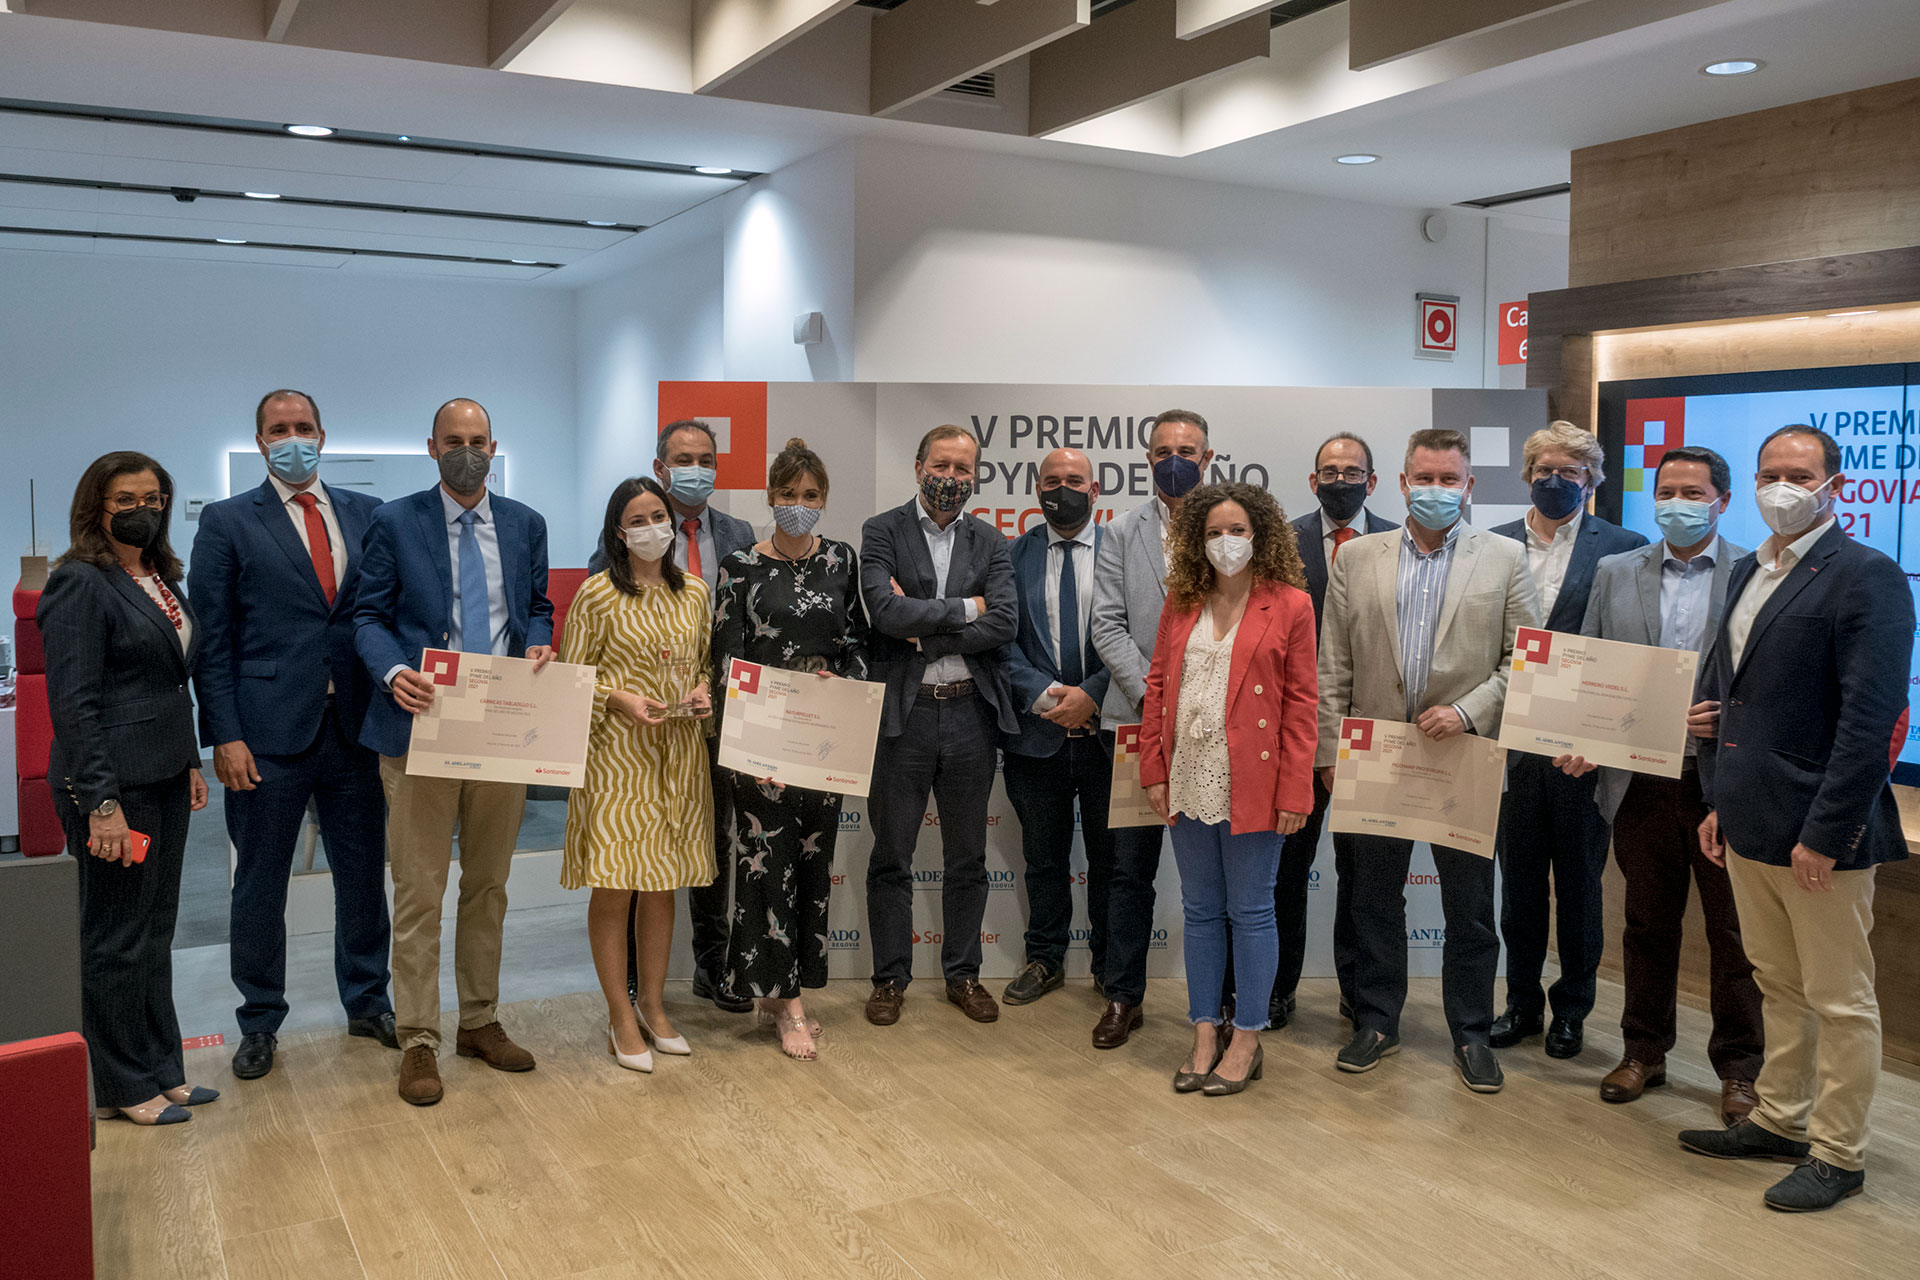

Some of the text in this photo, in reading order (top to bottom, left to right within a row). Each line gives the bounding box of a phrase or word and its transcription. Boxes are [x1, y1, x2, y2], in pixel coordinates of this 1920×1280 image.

[1506, 306, 1528, 328] Ca
[970, 415, 998, 449] V
[1810, 410, 1920, 436] V PREM
[1839, 444, 1887, 470] ME
[1098, 461, 1158, 496] DE
[1210, 453, 1269, 491] ÑO
[1839, 479, 1920, 505] GOVIA
[1834, 512, 1871, 538] 21
[543, 767, 571, 775] Santander
[1637, 754, 1667, 764] Santander
[833, 776, 858, 785] Santander
[1456, 832, 1481, 844] Santander
